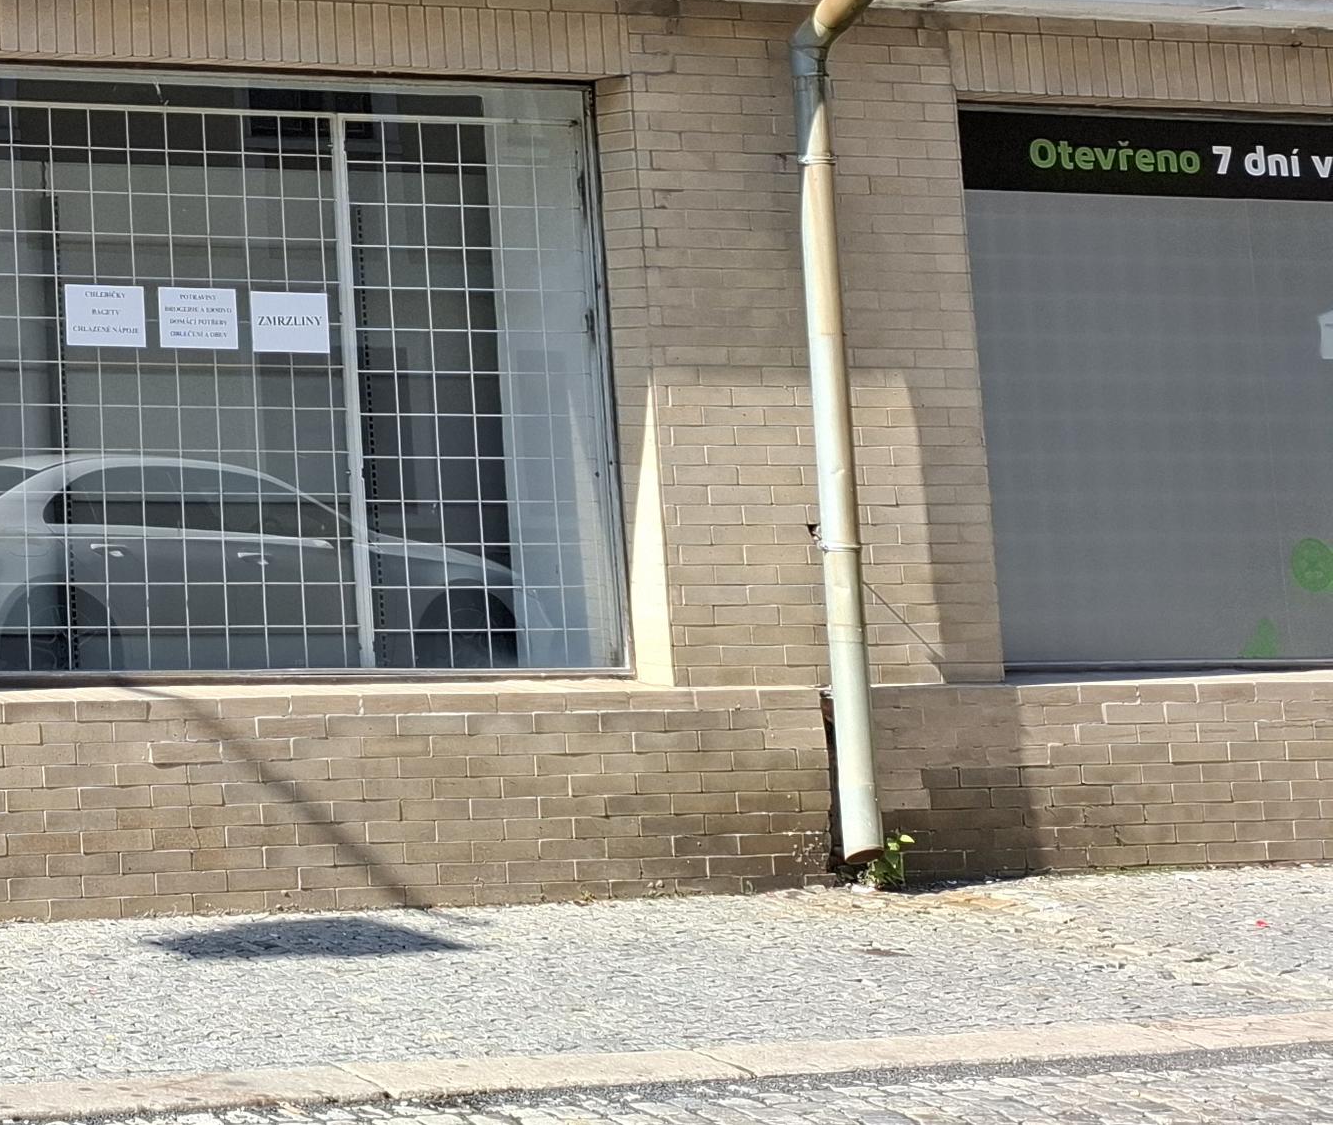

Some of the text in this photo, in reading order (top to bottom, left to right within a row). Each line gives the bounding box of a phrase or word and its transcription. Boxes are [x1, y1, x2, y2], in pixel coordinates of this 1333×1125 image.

[1030, 139, 1333, 178] Otevřeno 7 dní v
[257, 315, 323, 327] ZMRZLINY
